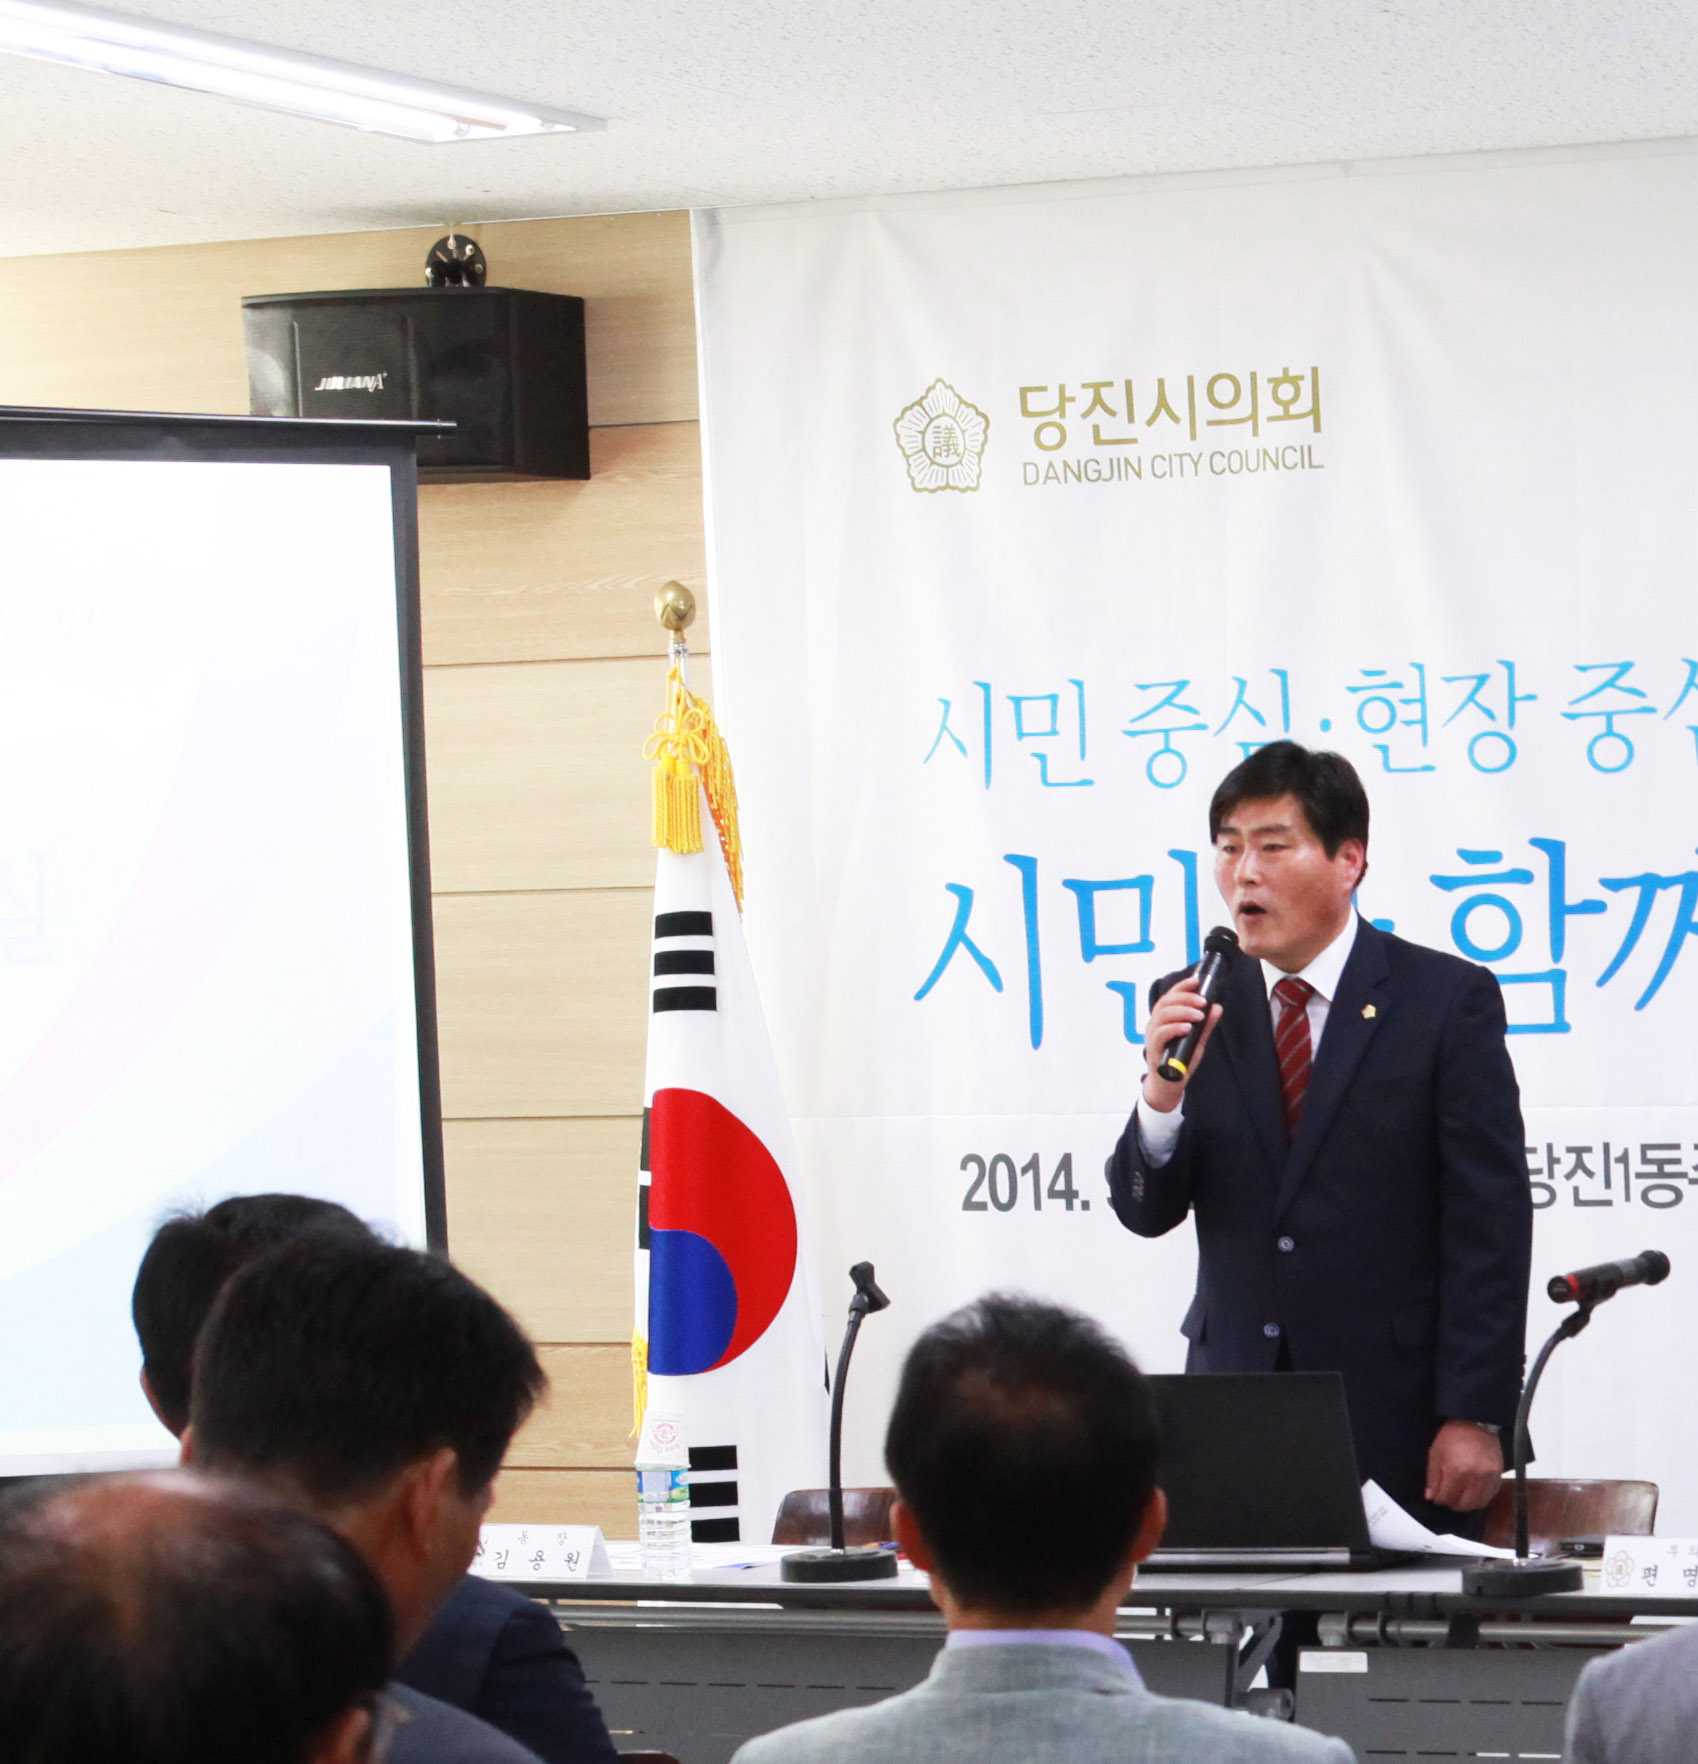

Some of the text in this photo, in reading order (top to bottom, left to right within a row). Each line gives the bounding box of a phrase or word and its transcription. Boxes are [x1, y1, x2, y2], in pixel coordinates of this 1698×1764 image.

[1019, 366, 1323, 452] 당진시의회
[1022, 445, 1324, 486] DANGJIN CITY COUNCIL
[923, 678, 1095, 790] 시민
[914, 848, 1395, 1050] 시민
[960, 1152, 1090, 1212] 2014.
